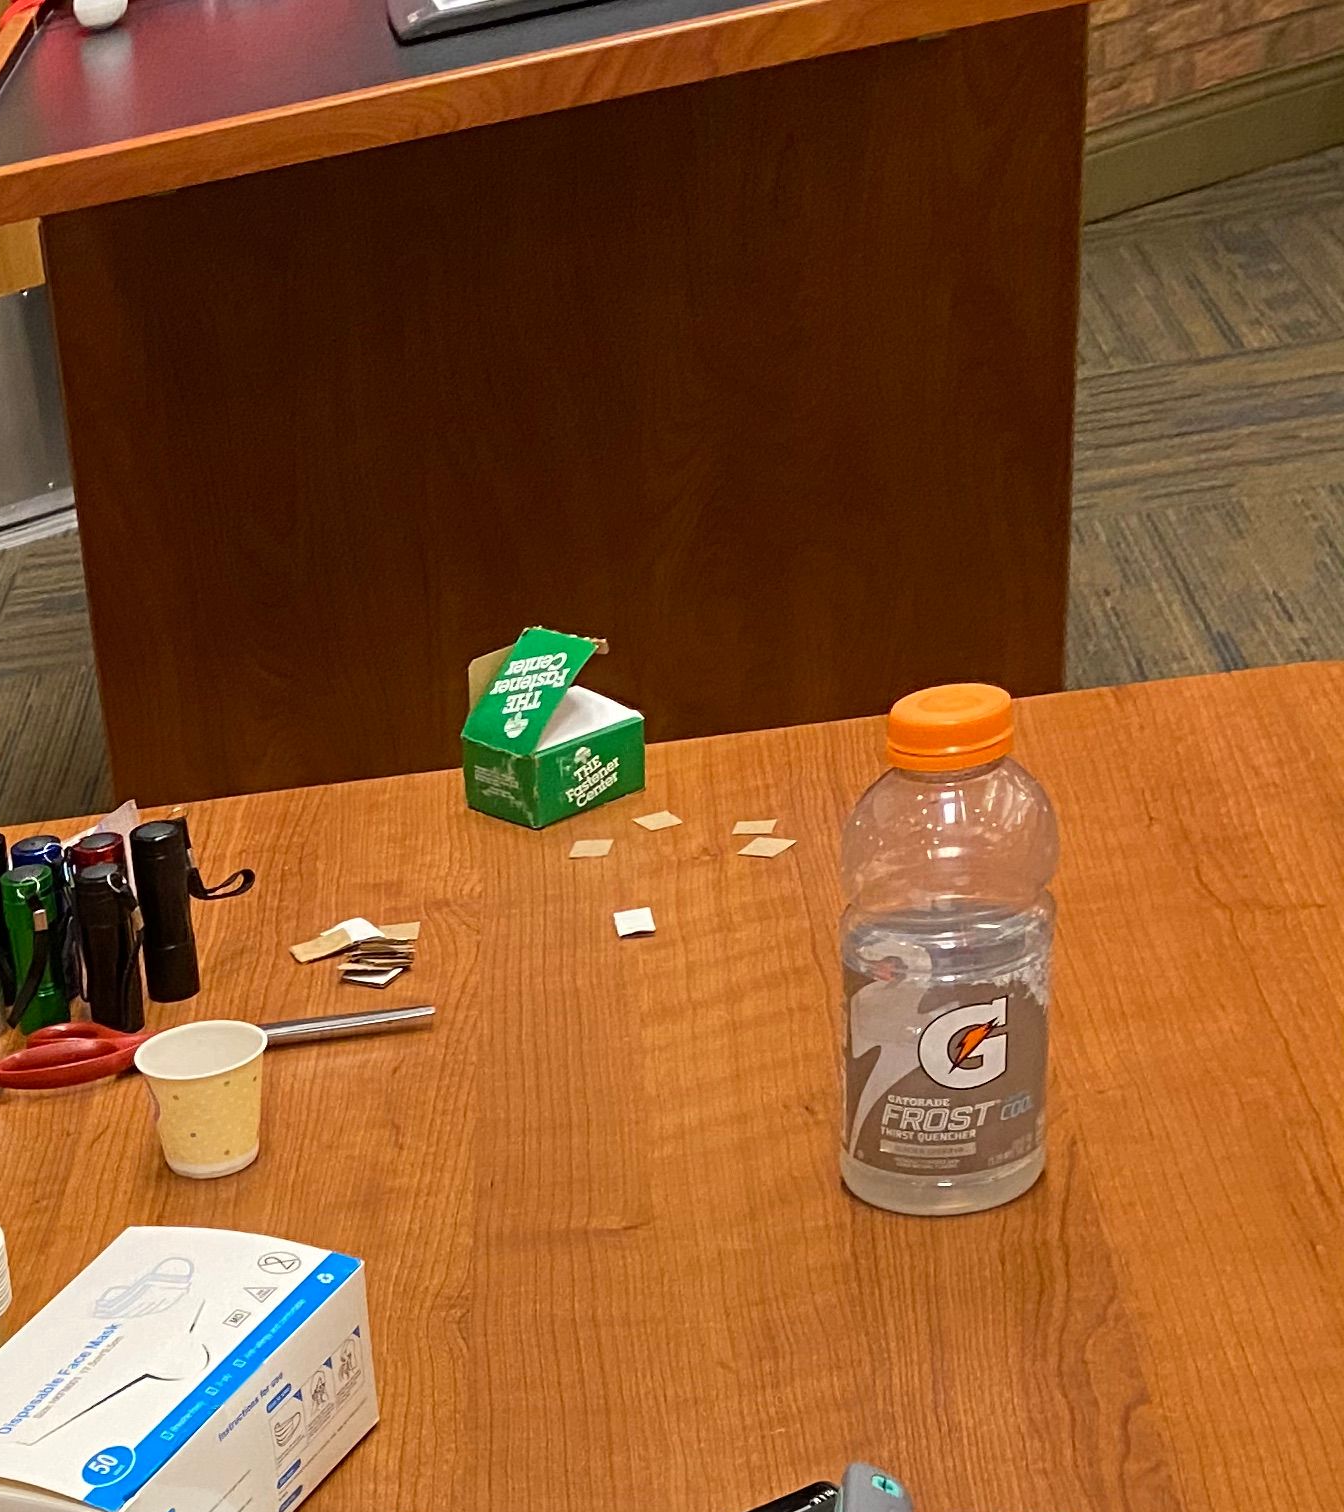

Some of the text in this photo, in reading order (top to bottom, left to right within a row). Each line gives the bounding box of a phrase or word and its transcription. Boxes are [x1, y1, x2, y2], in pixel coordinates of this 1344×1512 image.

[504, 652, 568, 676] Center
[489, 667, 571, 695] Fastener
[501, 690, 543, 714] THE
[565, 757, 620, 803] Fastener
[573, 755, 602, 782] THE
[576, 771, 618, 807] Center
[918, 995, 1008, 1090] G
[887, 1094, 950, 1107] GATORADE
[881, 1100, 995, 1132] FROST
[880, 1126, 976, 1143] THIRST QUENCHER
[57, 1350, 92, 1376] Face
[83, 1322, 123, 1349] Mask
[88, 1454, 119, 1475] 50
